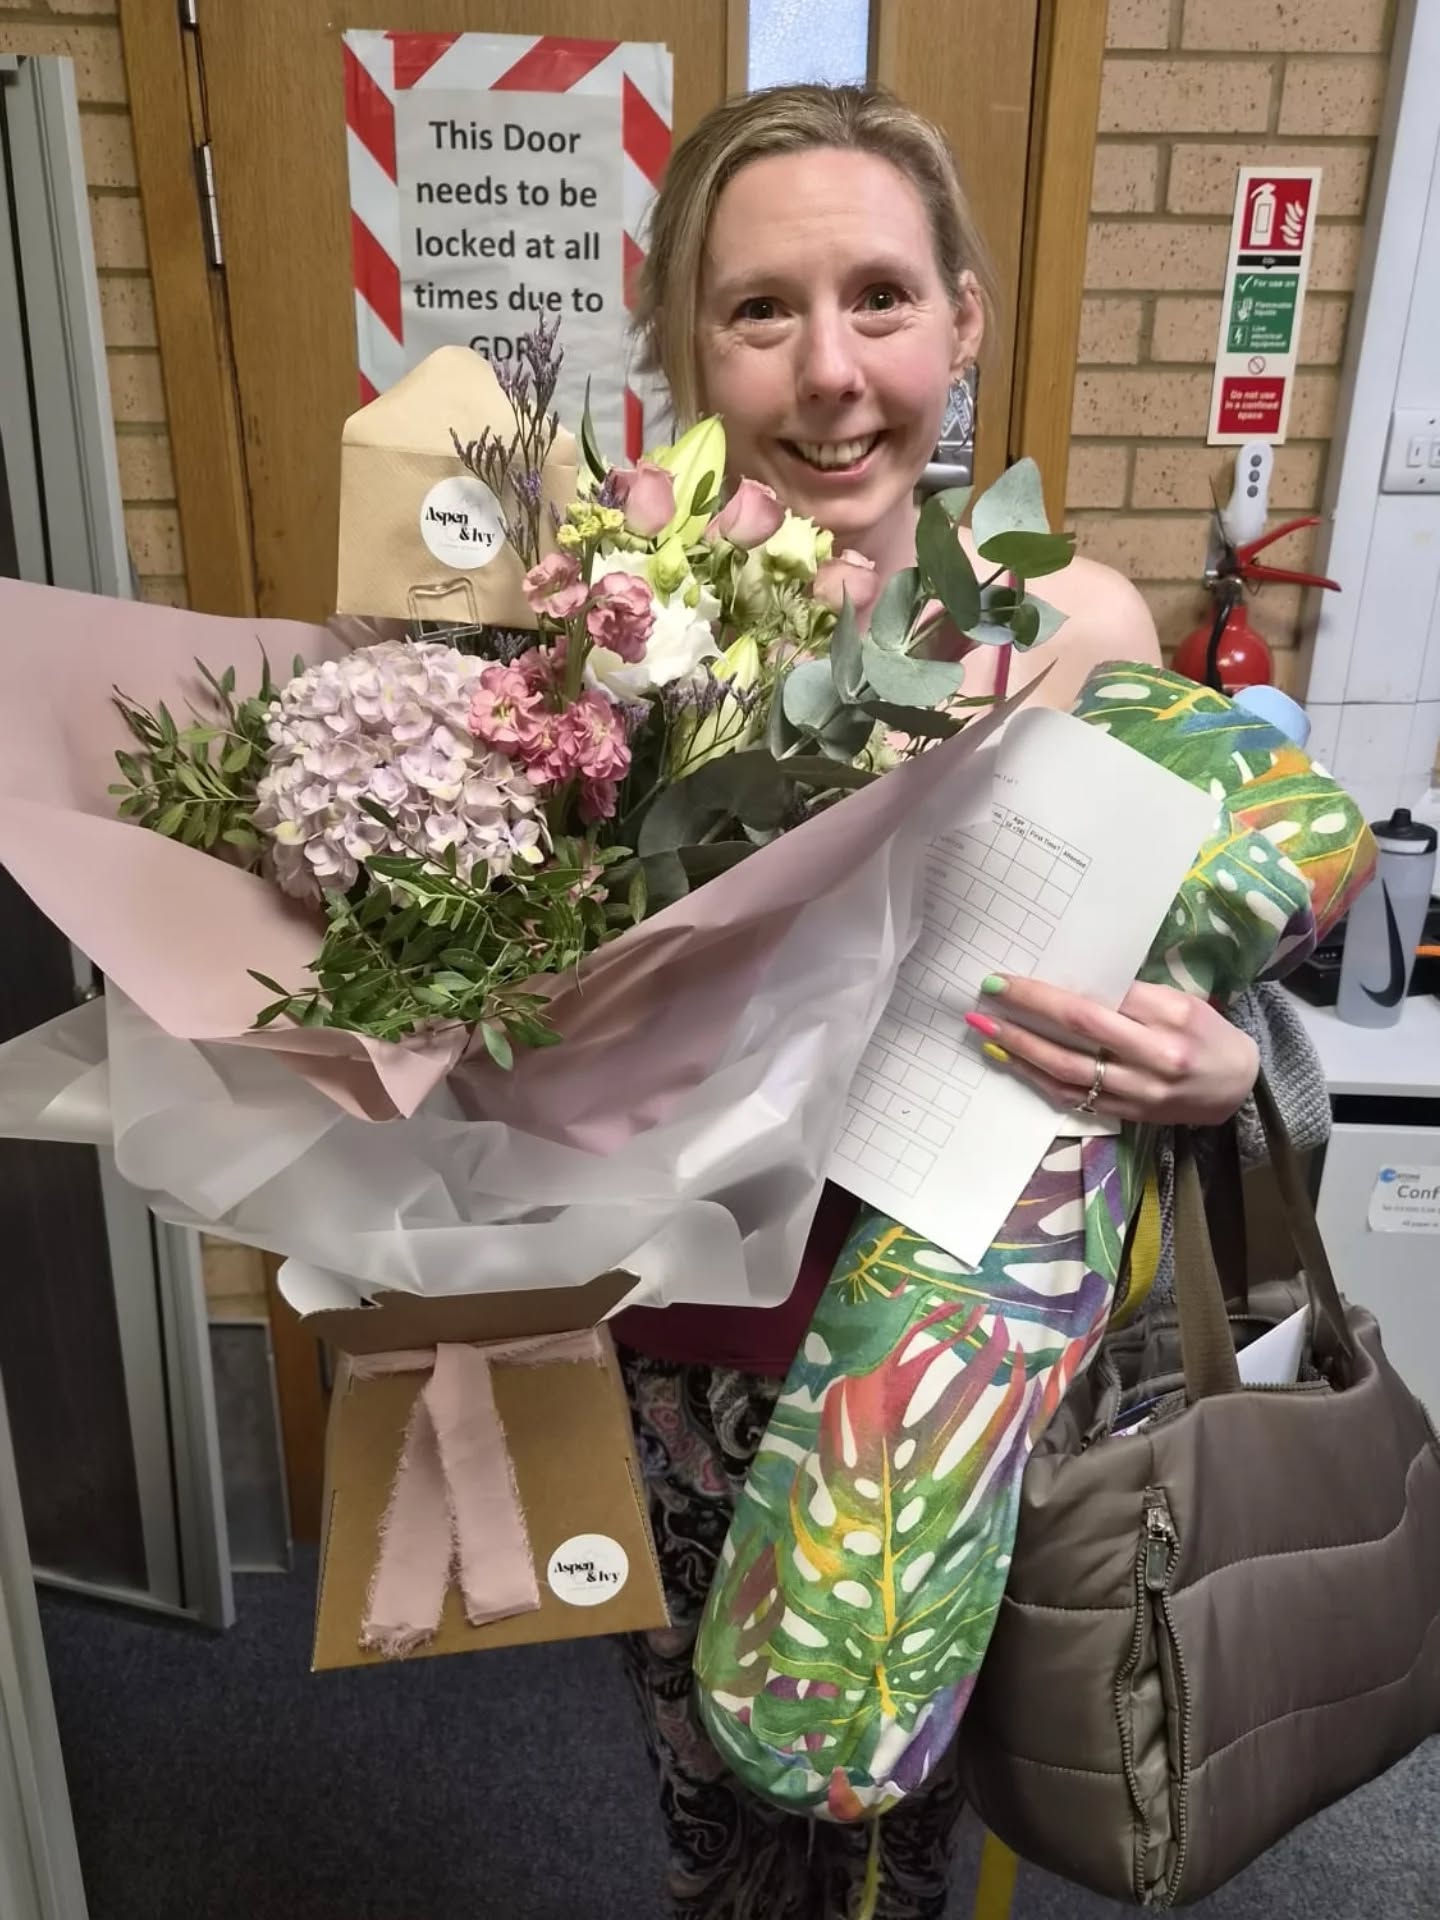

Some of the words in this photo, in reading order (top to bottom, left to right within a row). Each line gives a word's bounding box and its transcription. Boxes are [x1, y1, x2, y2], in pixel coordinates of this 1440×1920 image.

[429, 120, 493, 150] This
[504, 123, 581, 153] Door
[416, 176, 508, 205] needs
[517, 181, 549, 206] to
[560, 178, 597, 207] be
[416, 228, 516, 257] locked
[526, 234, 555, 259] at
[565, 232, 600, 260] all
[1253, 278, 1266, 288] For
[1268, 280, 1283, 288] use
[414, 283, 498, 309] times
[508, 283, 562, 312] due
[572, 288, 604, 313] to
[1230, 390, 1243, 400] Do
[1244, 391, 1259, 400] not
[1260, 392, 1277, 400] use
[1242, 401, 1280, 410] confined
[1237, 412, 1263, 422] space
[425, 506, 469, 526] Aspen
[554, 1562, 594, 1575] Aspen
